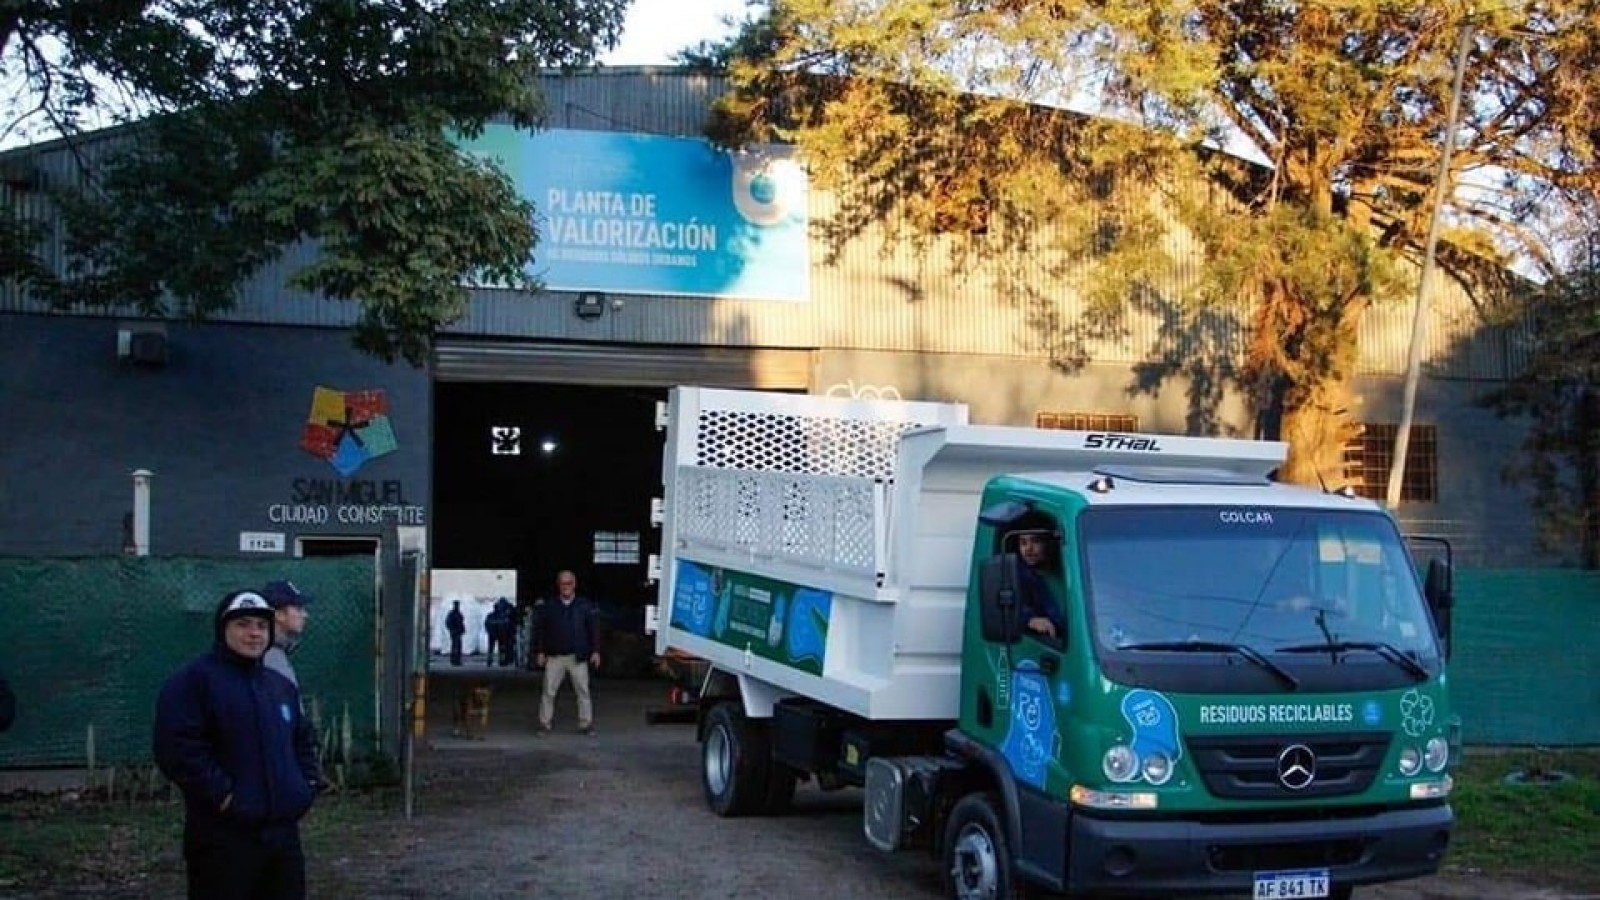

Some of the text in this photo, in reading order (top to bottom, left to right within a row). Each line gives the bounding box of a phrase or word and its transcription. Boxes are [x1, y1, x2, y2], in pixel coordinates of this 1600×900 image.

[548, 187, 656, 217] PLANTA DE
[549, 217, 717, 250] VALORIZACIÓN
[292, 478, 407, 504] SAN MIGUEL
[268, 504, 328, 523] CIUDAD
[1219, 511, 1274, 524] COLCAR
[1200, 705, 1266, 723] RESIDUOS
[1269, 704, 1353, 722] RECICLABLES
[1257, 879, 1326, 897] AF 841 TK
